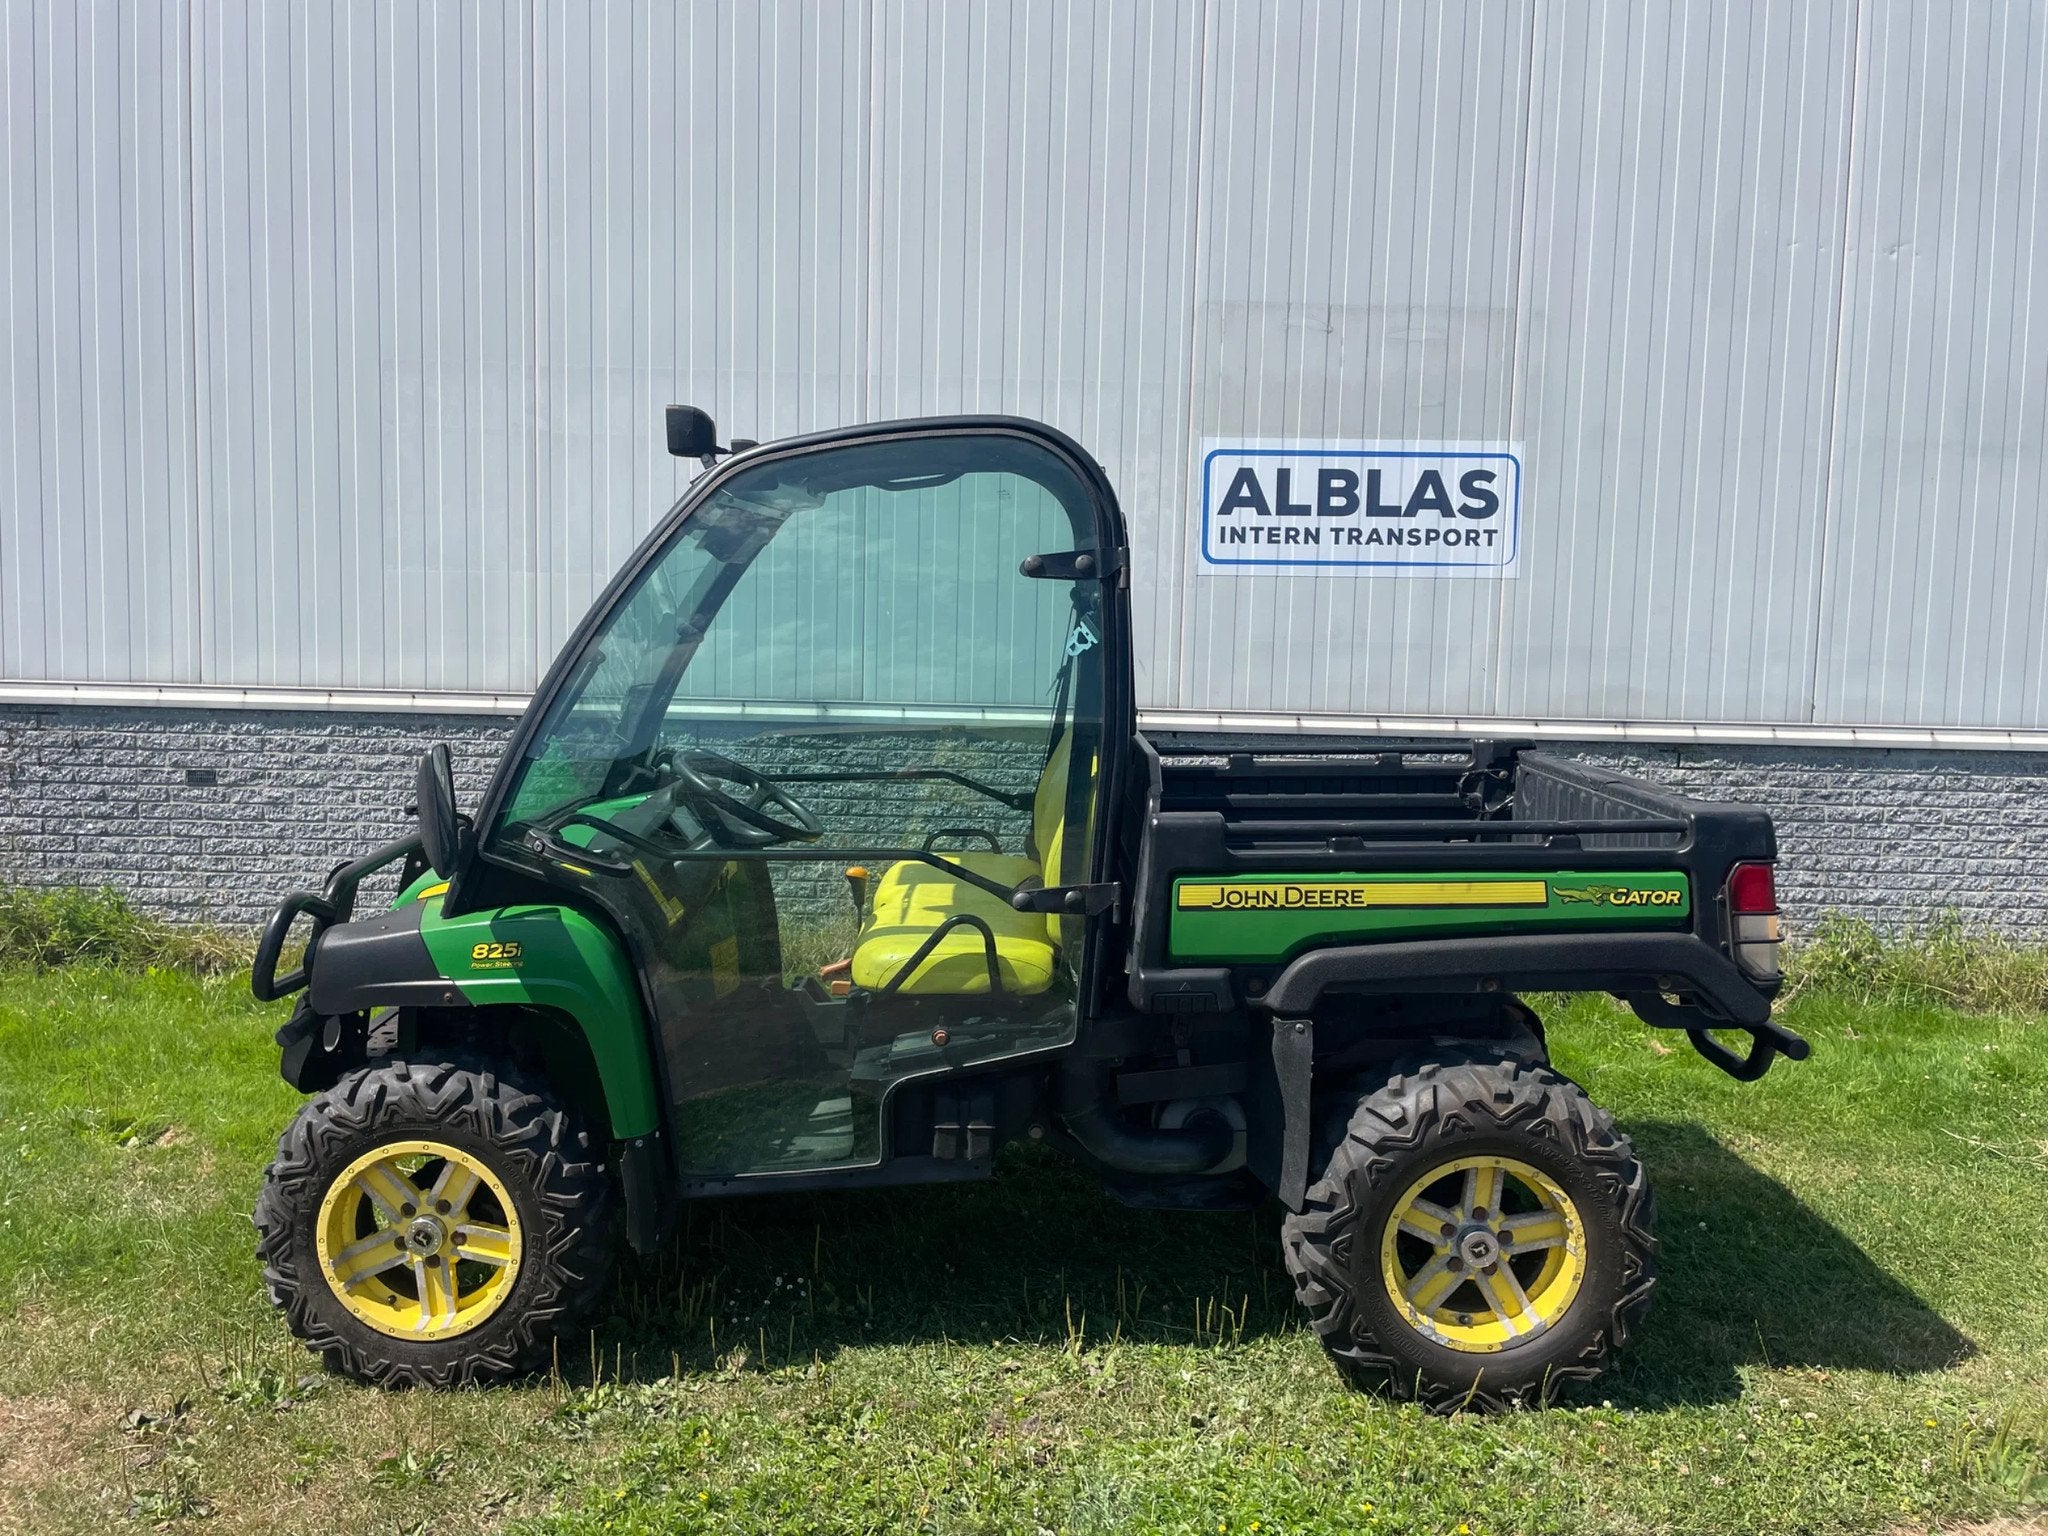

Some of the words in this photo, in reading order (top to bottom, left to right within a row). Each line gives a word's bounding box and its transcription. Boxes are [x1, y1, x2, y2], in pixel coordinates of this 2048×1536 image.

[1217, 467, 1499, 519] ALBLAS
[1220, 526, 1320, 545] INTERN
[1330, 527, 1499, 547] TRANSPORT
[1212, 886, 1280, 908] JOHN
[1285, 887, 1365, 907] DEERE
[1609, 887, 1682, 907] GATOR
[472, 942, 522, 960] 825i
